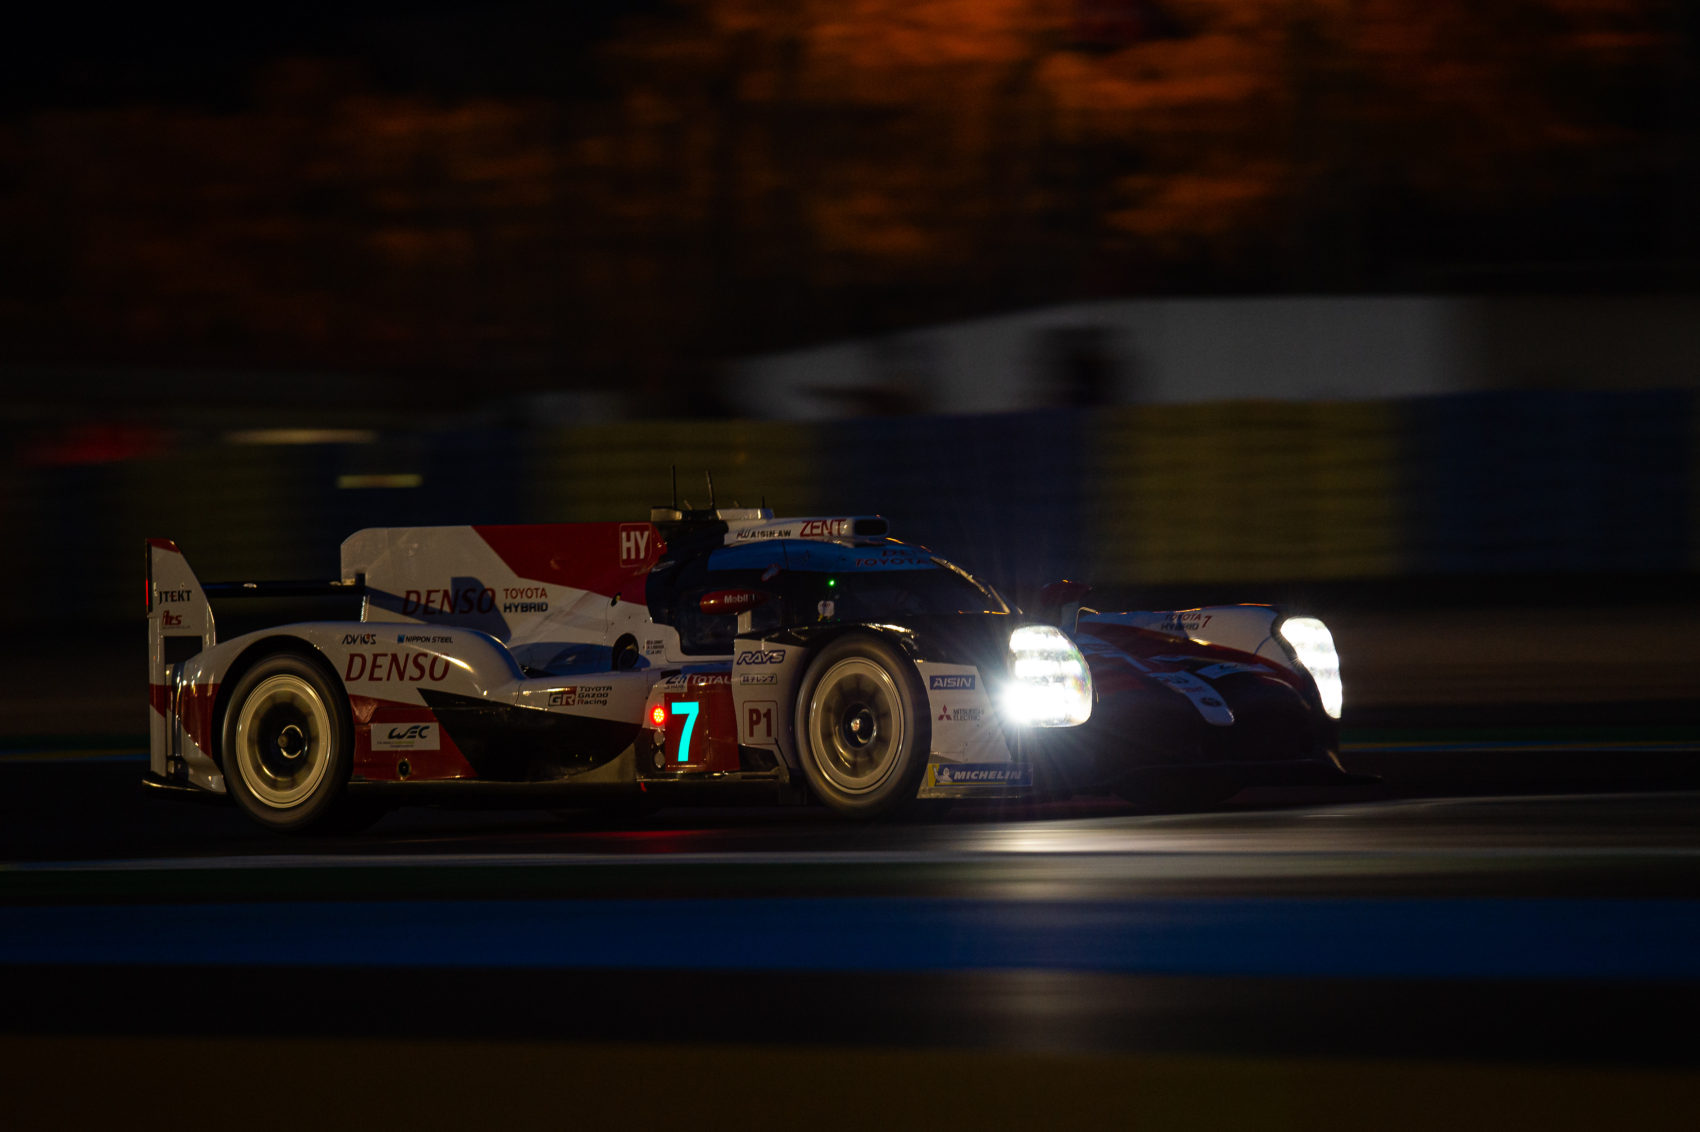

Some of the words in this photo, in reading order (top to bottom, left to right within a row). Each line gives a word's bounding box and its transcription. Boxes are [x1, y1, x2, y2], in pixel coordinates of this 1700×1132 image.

[800, 520, 847, 537] ZENT
[621, 530, 649, 560] HY
[159, 590, 192, 605] JTEKT
[503, 588, 548, 599] TOYOTA
[724, 593, 749, 604] Mobil
[401, 588, 496, 615] DENSO
[503, 602, 548, 613] HYBRID
[1202, 615, 1213, 628] 7
[405, 635, 430, 644] NIPPON
[431, 635, 454, 644] STEEL
[736, 649, 786, 665] RAYS
[345, 652, 451, 681] DENSO
[692, 673, 731, 685] TOTAL
[932, 676, 972, 689] AISIN
[548, 693, 575, 706] GR
[748, 708, 772, 738] P1
[388, 725, 431, 739] WEC
[671, 701, 699, 762] 7
[953, 770, 1022, 780] MICHELIN
